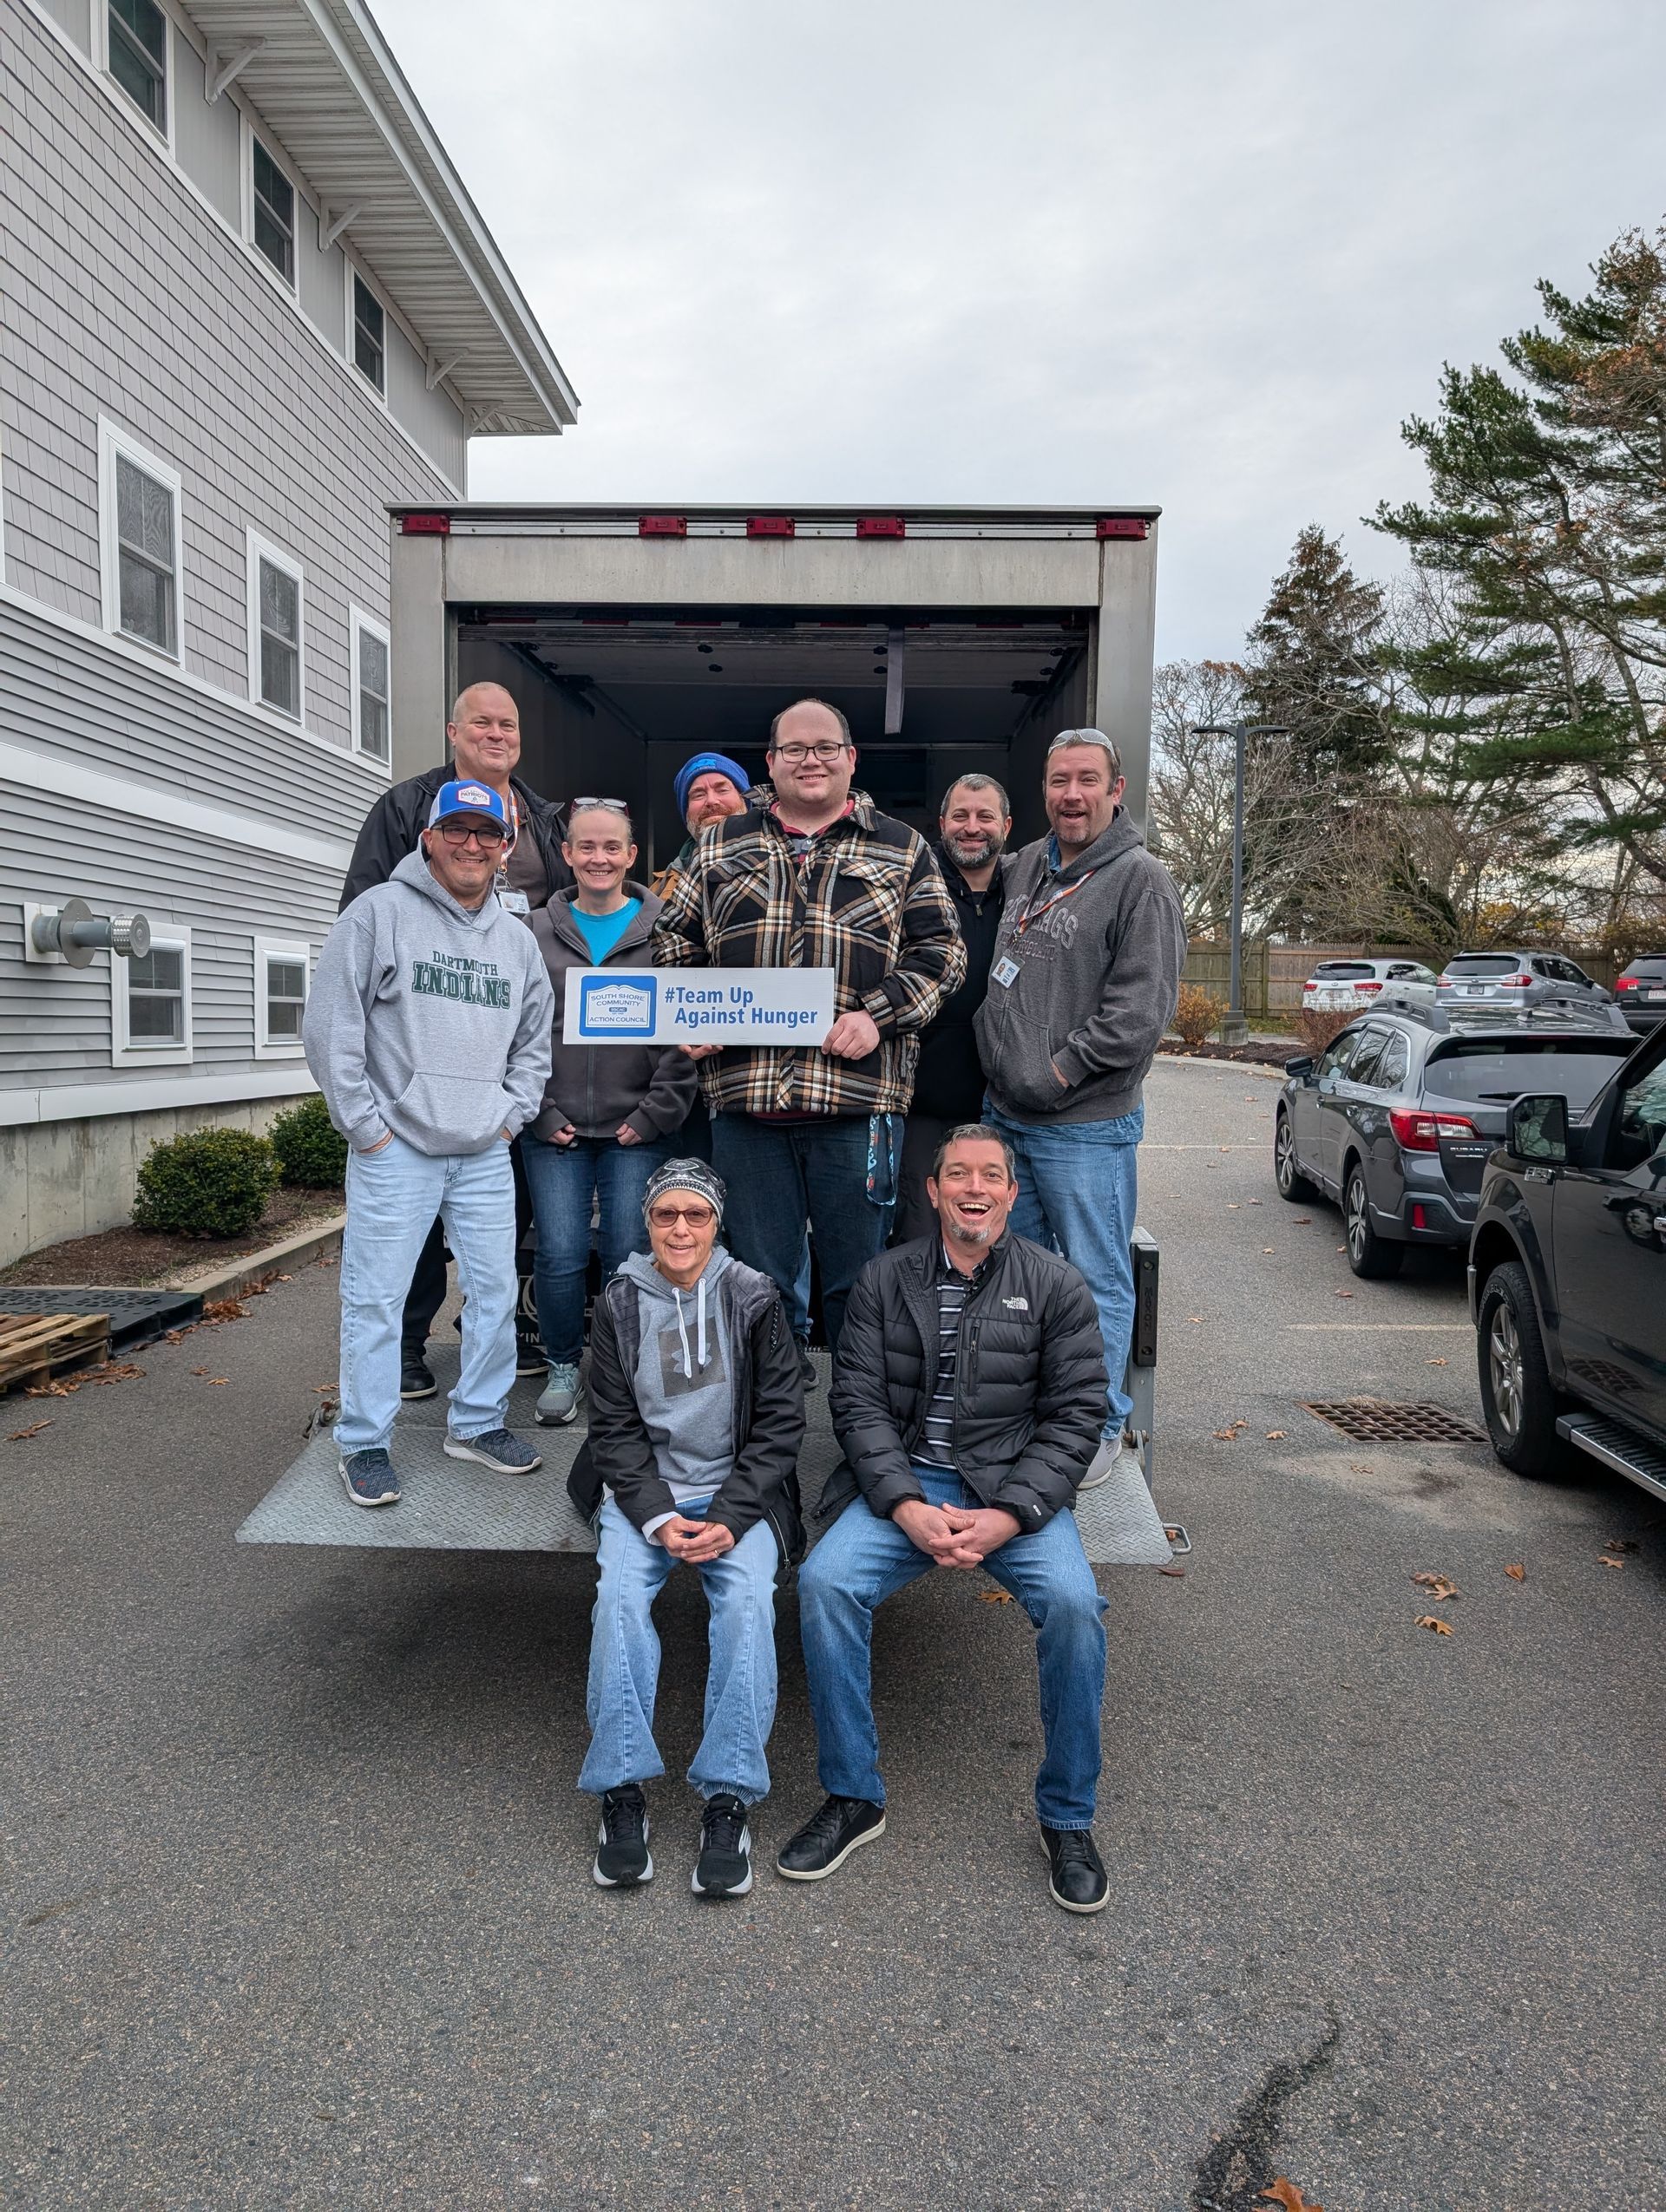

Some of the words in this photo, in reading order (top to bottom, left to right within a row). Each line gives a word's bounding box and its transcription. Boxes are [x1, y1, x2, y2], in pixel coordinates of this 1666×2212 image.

[411, 960, 511, 1010] INDIANS
[618, 993, 646, 1002] SHORE
[665, 986, 723, 1004] #Team
[730, 986, 754, 1008] Up
[674, 1006, 744, 1029] Against
[751, 1007, 818, 1029] Hunger
